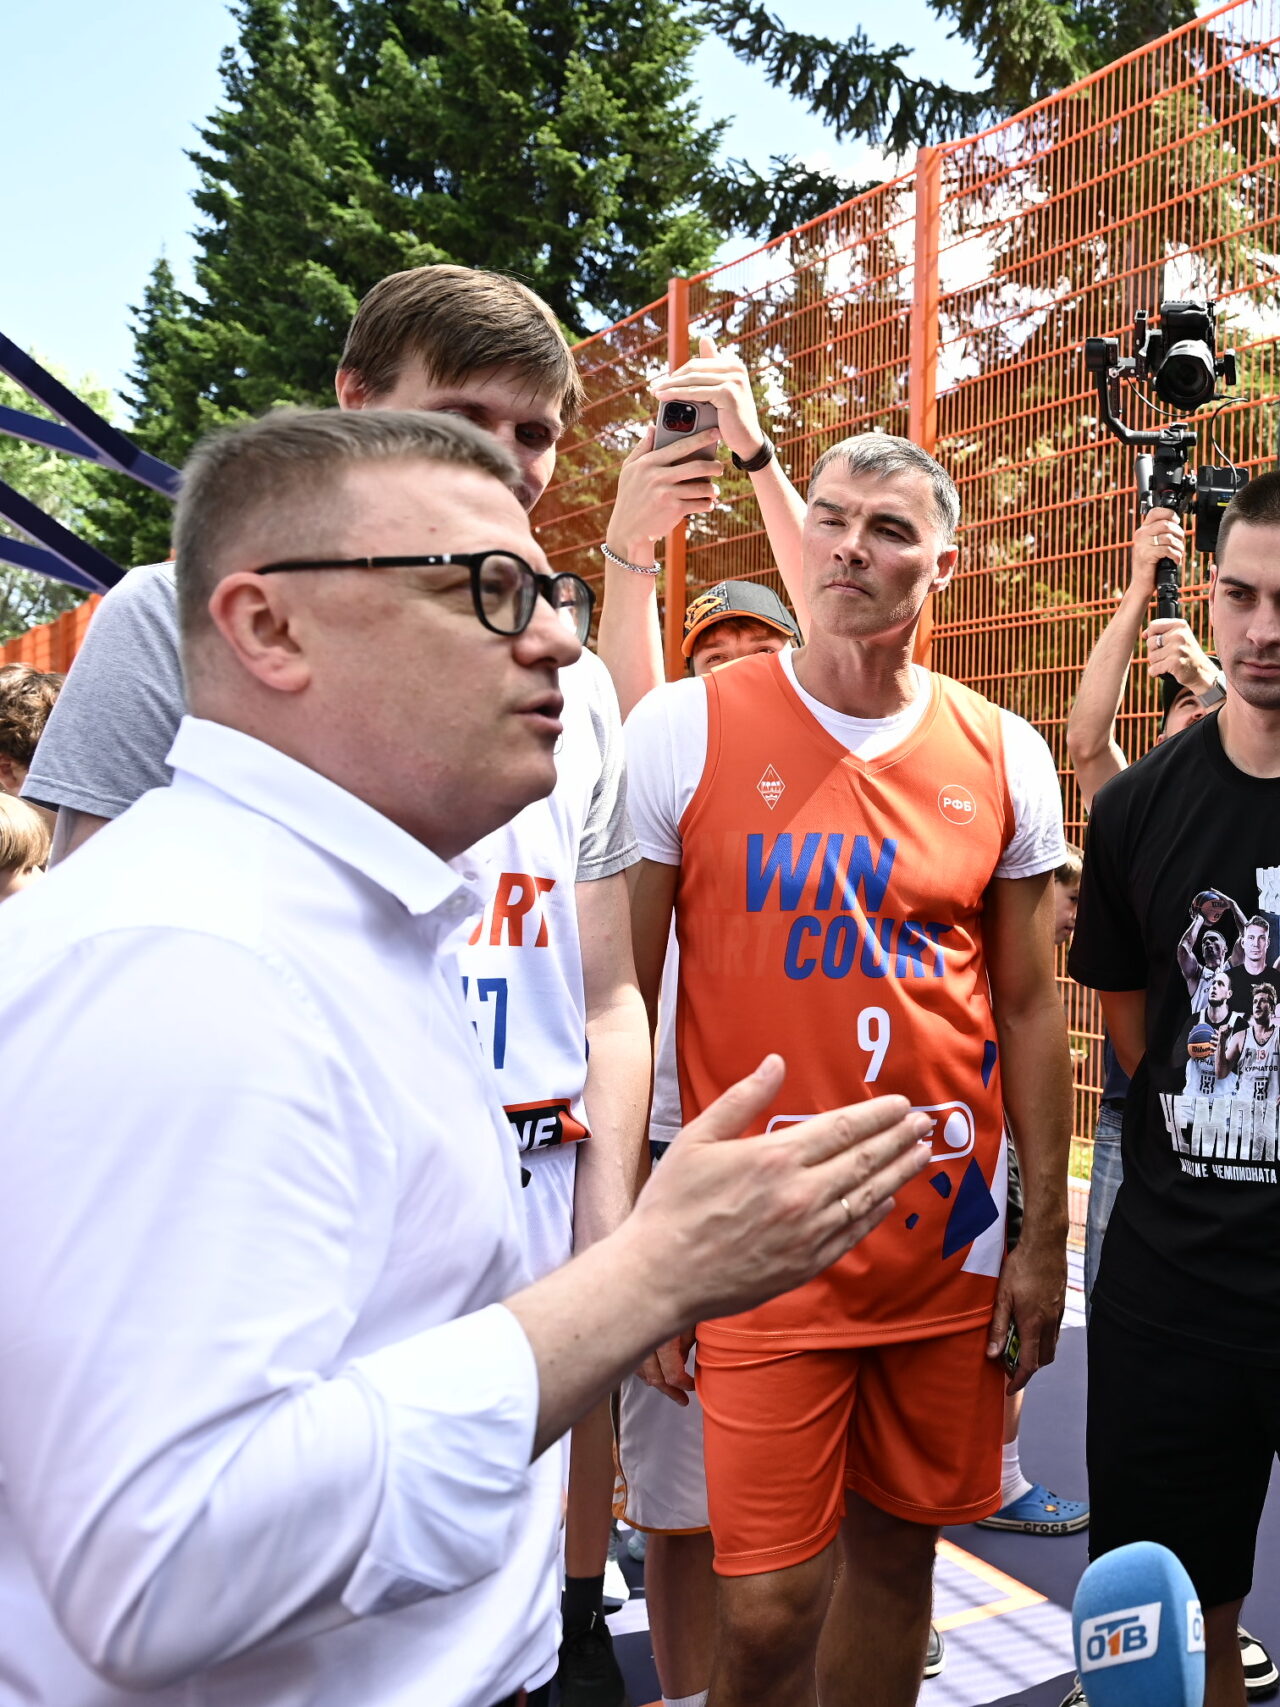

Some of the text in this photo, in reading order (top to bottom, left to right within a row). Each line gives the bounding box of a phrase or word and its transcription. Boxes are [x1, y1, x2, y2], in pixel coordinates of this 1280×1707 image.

[943, 797, 972, 812] РФБ
[746, 832, 899, 913] WIN
[784, 915, 955, 980] COURT
[857, 1006, 890, 1082] 9
[1244, 1065, 1279, 1073] КУРЧАТОВ
[1212, 1163, 1277, 1184] ЧЕМПИОНАТА
[1023, 1521, 1069, 1534] crocs
